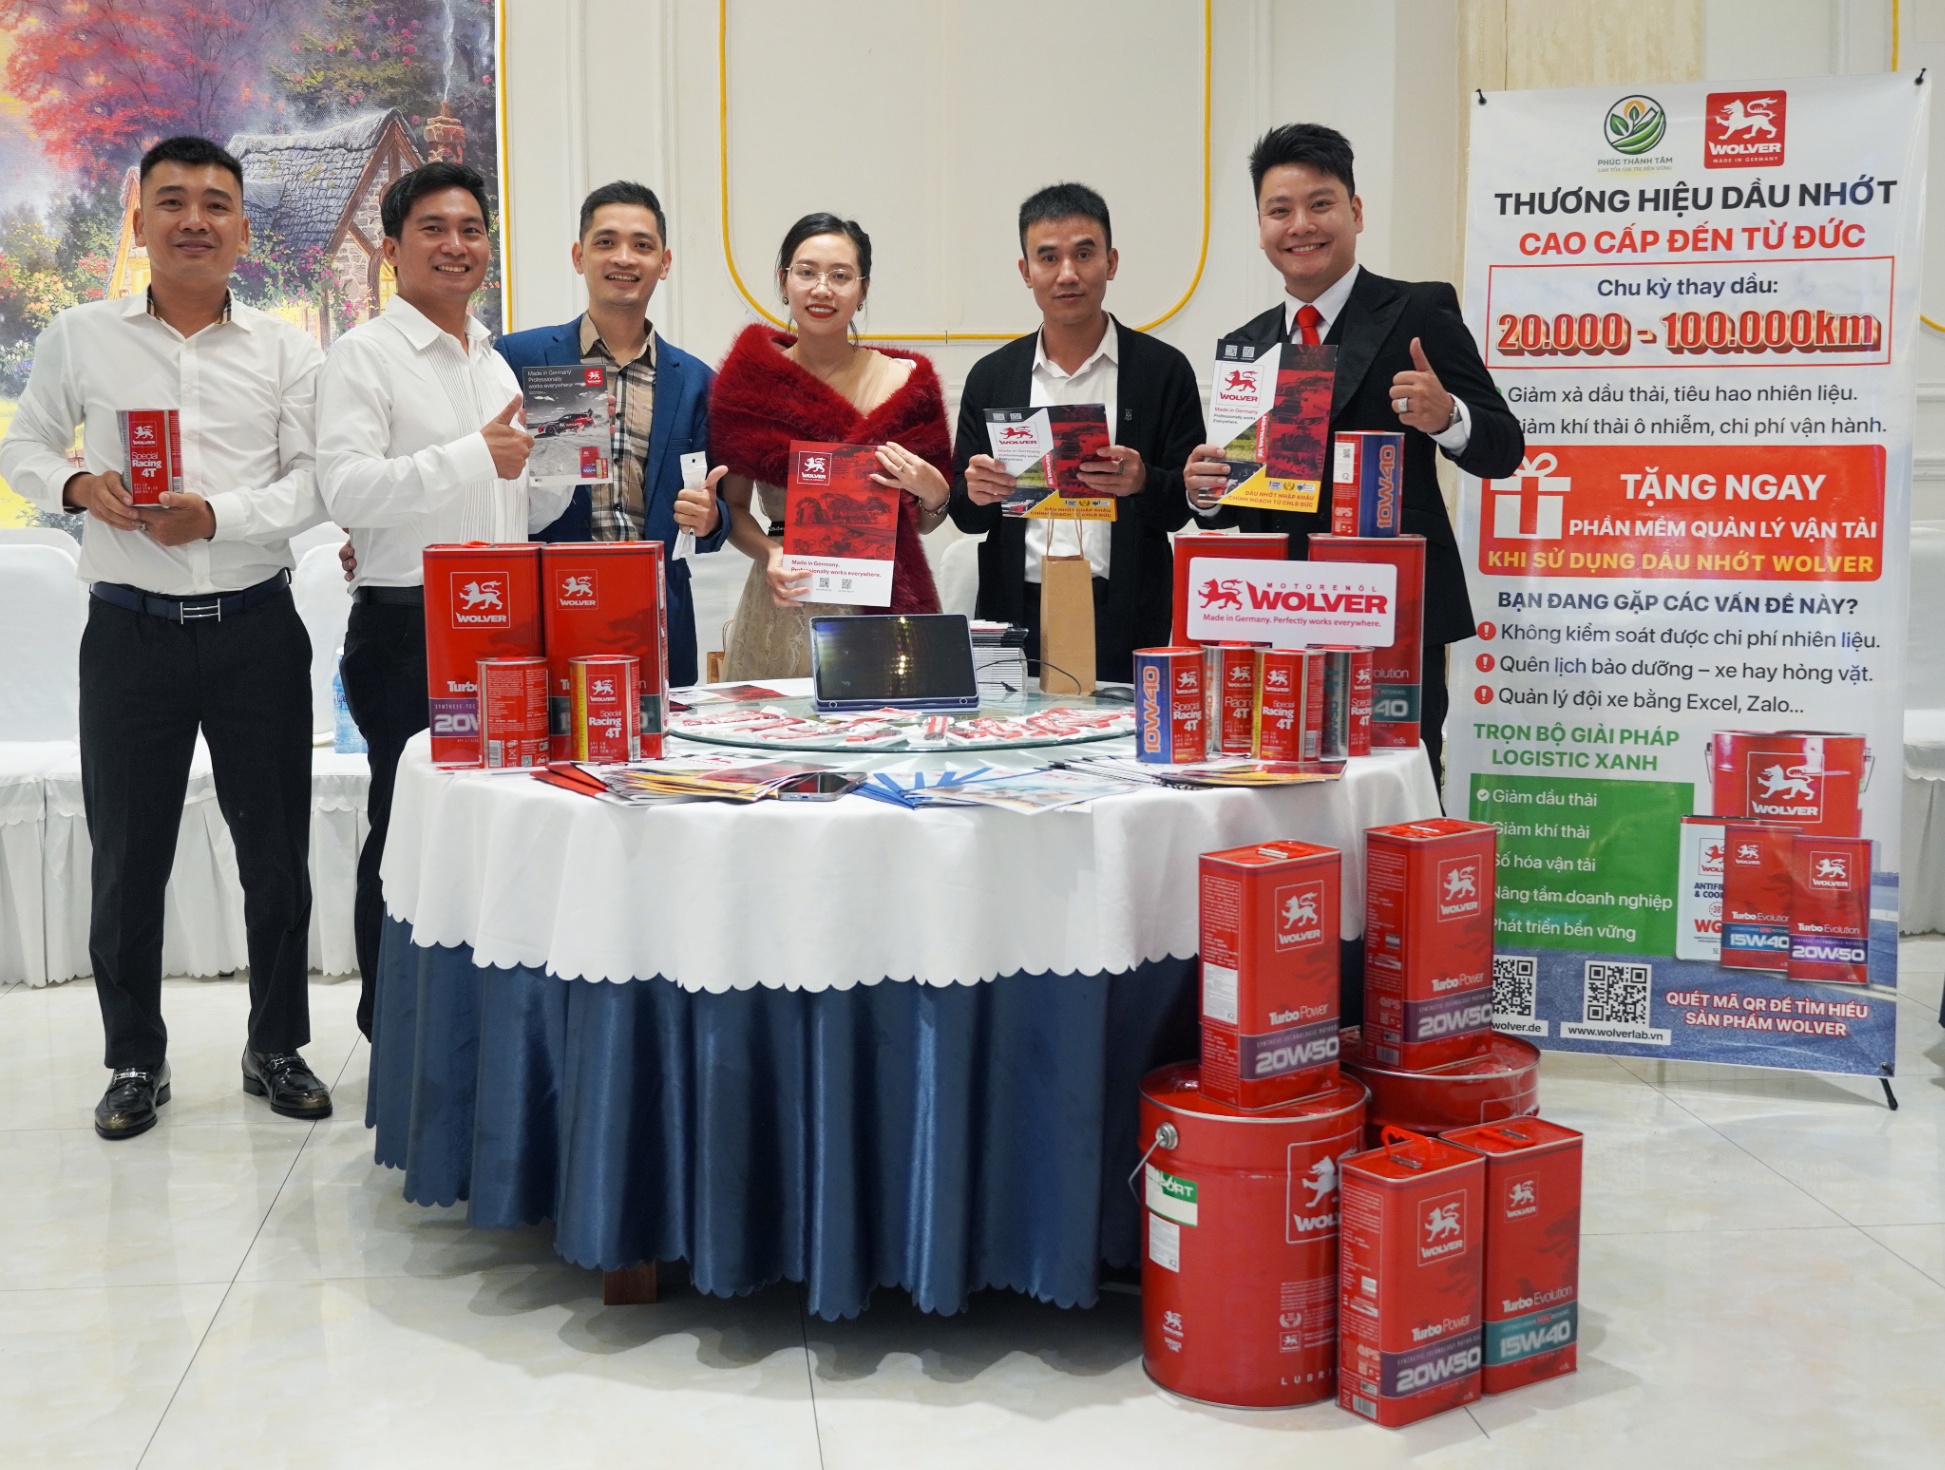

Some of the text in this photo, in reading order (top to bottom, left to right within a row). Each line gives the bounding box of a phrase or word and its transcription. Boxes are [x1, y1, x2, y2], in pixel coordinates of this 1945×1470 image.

[1708, 141, 1781, 155] WOLVER
[1598, 156, 1673, 166] PHÚC THÀNH TÂM
[1494, 174, 1897, 218] THƯƠNG HIỆU DẦU NHỚT
[1519, 217, 1866, 256] CAO CẤP ĐẾN TỪ ĐỨC
[1597, 272, 1778, 299] Chu kỳ thay dầu:
[1496, 309, 1882, 357] 20.000 100.000km
[1219, 392, 1258, 403] WOLVER
[1508, 383, 1858, 405] Giảm xả dầu thải, tiêu hao nhiên liệu.
[1517, 414, 1887, 438] iảm khí thải ô nhiễm, chi phí vận hành.
[132, 451, 158, 461] Special
[132, 460, 162, 468] Racing
[141, 468, 157, 478] 4T
[1620, 466, 1826, 507] TẶNG NGAY
[1569, 515, 1877, 543] PHẦN MỀM QUẢN LÝ VẬN TẢI
[1488, 547, 1874, 574] KHI SỬ DỤNG DẦU NHỚT WOLVER
[1245, 580, 1388, 614] WOLVER
[1266, 582, 1377, 592] MOTORENÖL
[560, 598, 596, 606] WOLVER
[1498, 590, 1858, 615] BẠN ĐANG GẶP CÁC VẤN ĐỀ NÀY?
[456, 612, 507, 623] WOLVER
[1203, 613, 1224, 621] Made
[1235, 614, 1272, 624] Germany.
[1273, 616, 1307, 626] Perfectly
[1308, 617, 1332, 625] works
[1333, 619, 1382, 628] everywhere.
[1501, 622, 1880, 652] Không kiểm soát được chi phí nhiên liệu.
[1500, 655, 1873, 685] Quên lịch bảo dưỡng xe hay hỏng vặt.
[1498, 687, 1804, 714] Quản lý đội xe bằng Excel, Zalo...
[588, 716, 622, 727] Racing
[600, 710, 622, 718] Special
[1262, 706, 1294, 718] Racing
[605, 727, 622, 738] 4T
[1276, 718, 1294, 730] 4T
[1473, 721, 1680, 747] TRỌN BỘ GIẢI PHÁP
[1491, 748, 1658, 771] LOGISTIC XANH
[1492, 788, 1598, 807] Giảm dầu thải
[1752, 801, 1818, 816] WOLVER
[1493, 820, 1590, 839] Giảm khí thải
[1514, 855, 1596, 873] hóa vận tải
[1533, 885, 1673, 912] tầm doanh nghiệp
[1278, 929, 1321, 944] WOLVER
[1525, 918, 1636, 942] triển bền vững
[1665, 989, 1869, 1018] QUÉT MÃ QR ĐỂ TÌM HIỂU
[1269, 1003, 1328, 1026] Turbo Power
[1685, 1009, 1847, 1036] SẢN PHẨM WOLVER
[1568, 1026, 1664, 1042] www.wolverlab.vn
[1505, 1206, 1537, 1218] WOLVER
[1502, 1285, 1573, 1313] Turbo Evolution
